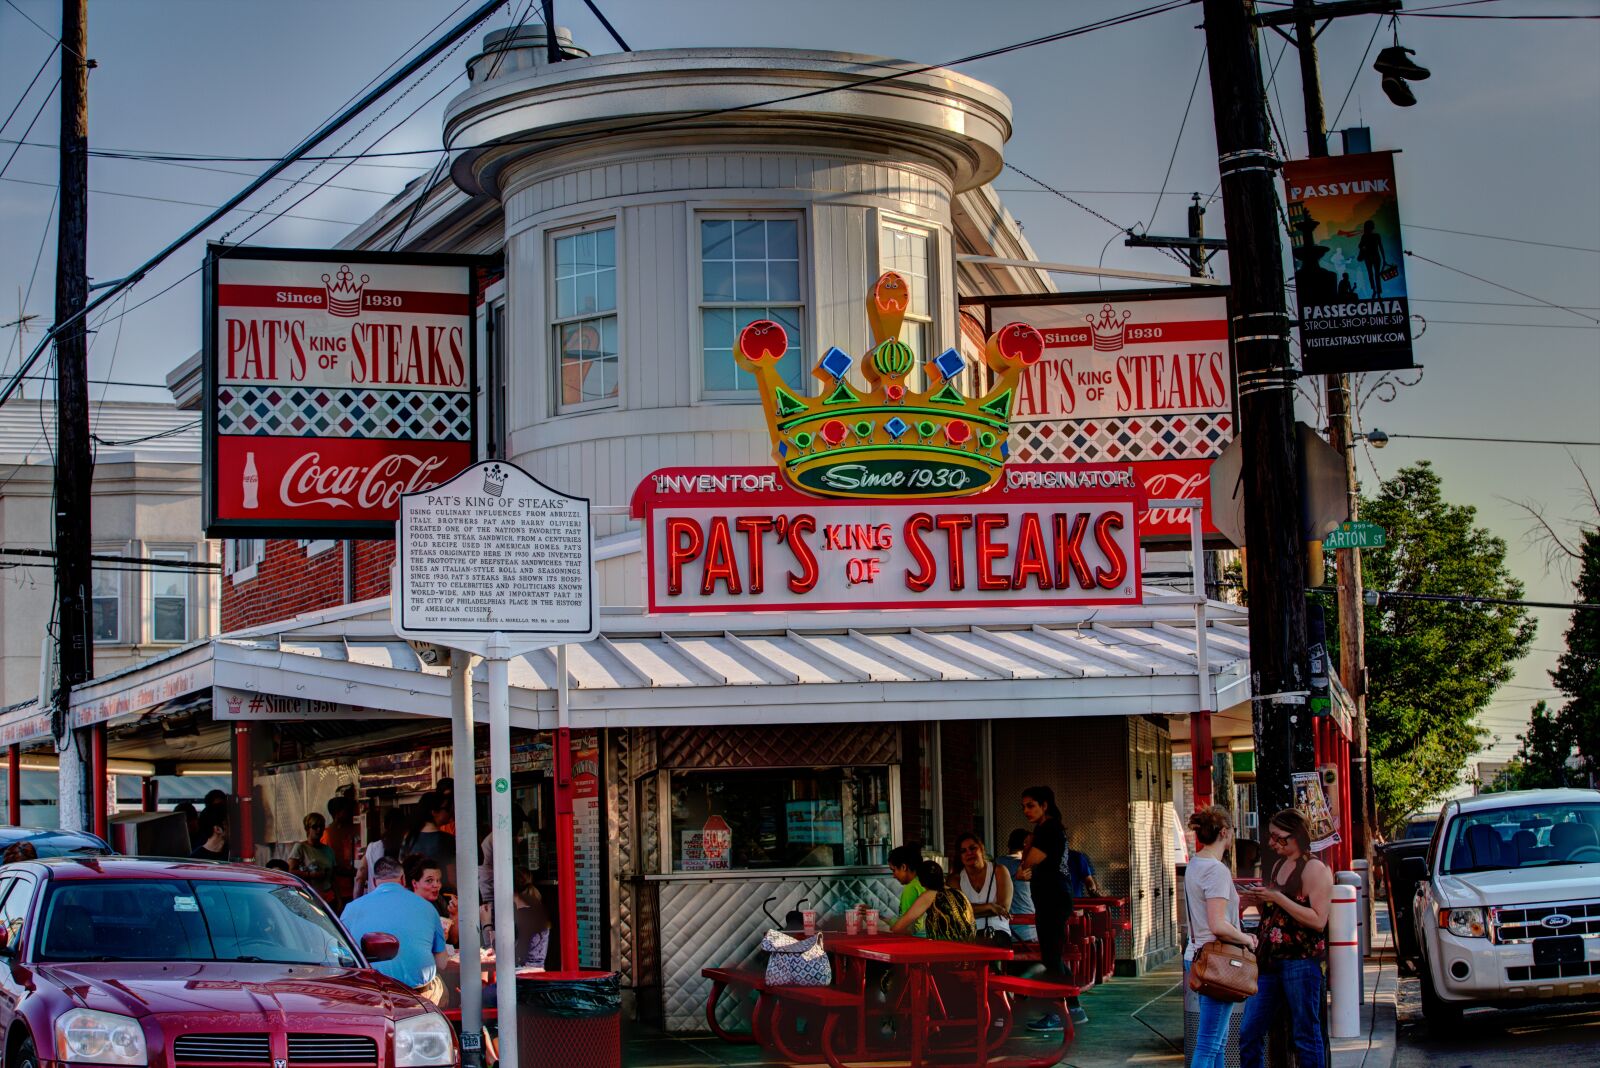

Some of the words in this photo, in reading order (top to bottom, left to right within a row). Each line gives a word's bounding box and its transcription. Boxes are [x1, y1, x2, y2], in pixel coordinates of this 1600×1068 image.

[1290, 178, 1390, 200] PASSYUNK
[276, 291, 322, 304] Since
[365, 296, 402, 307] 1930
[1303, 300, 1403, 320] PASSEGGIATA
[1045, 332, 1088, 344] Since
[1127, 328, 1163, 339] 1930
[1306, 333, 1406, 348] VISITEASTPASSYUNK.COM
[225, 318, 307, 381] PAT'S
[309, 336, 346, 352] KING
[350, 322, 464, 388] STEAKS
[318, 354, 338, 369] OF
[1015, 357, 1076, 416] AT'S
[1077, 370, 1112, 385] KING
[1116, 351, 1226, 412] STEAKS
[1086, 387, 1105, 401] OF
[656, 474, 776, 493] INVENTOR
[826, 465, 905, 489] Since
[908, 468, 967, 489] 1930
[1007, 470, 1131, 489] ORIGINATOR
[465, 496, 494, 507] KING
[498, 498, 514, 508] OF
[1326, 531, 1367, 547] ARTON
[1373, 535, 1383, 545] ST
[665, 513, 819, 595] PAT'S
[825, 523, 893, 551] KING
[903, 511, 1128, 592] STEAKS
[846, 557, 881, 585] OF
[248, 694, 302, 714] #Since
